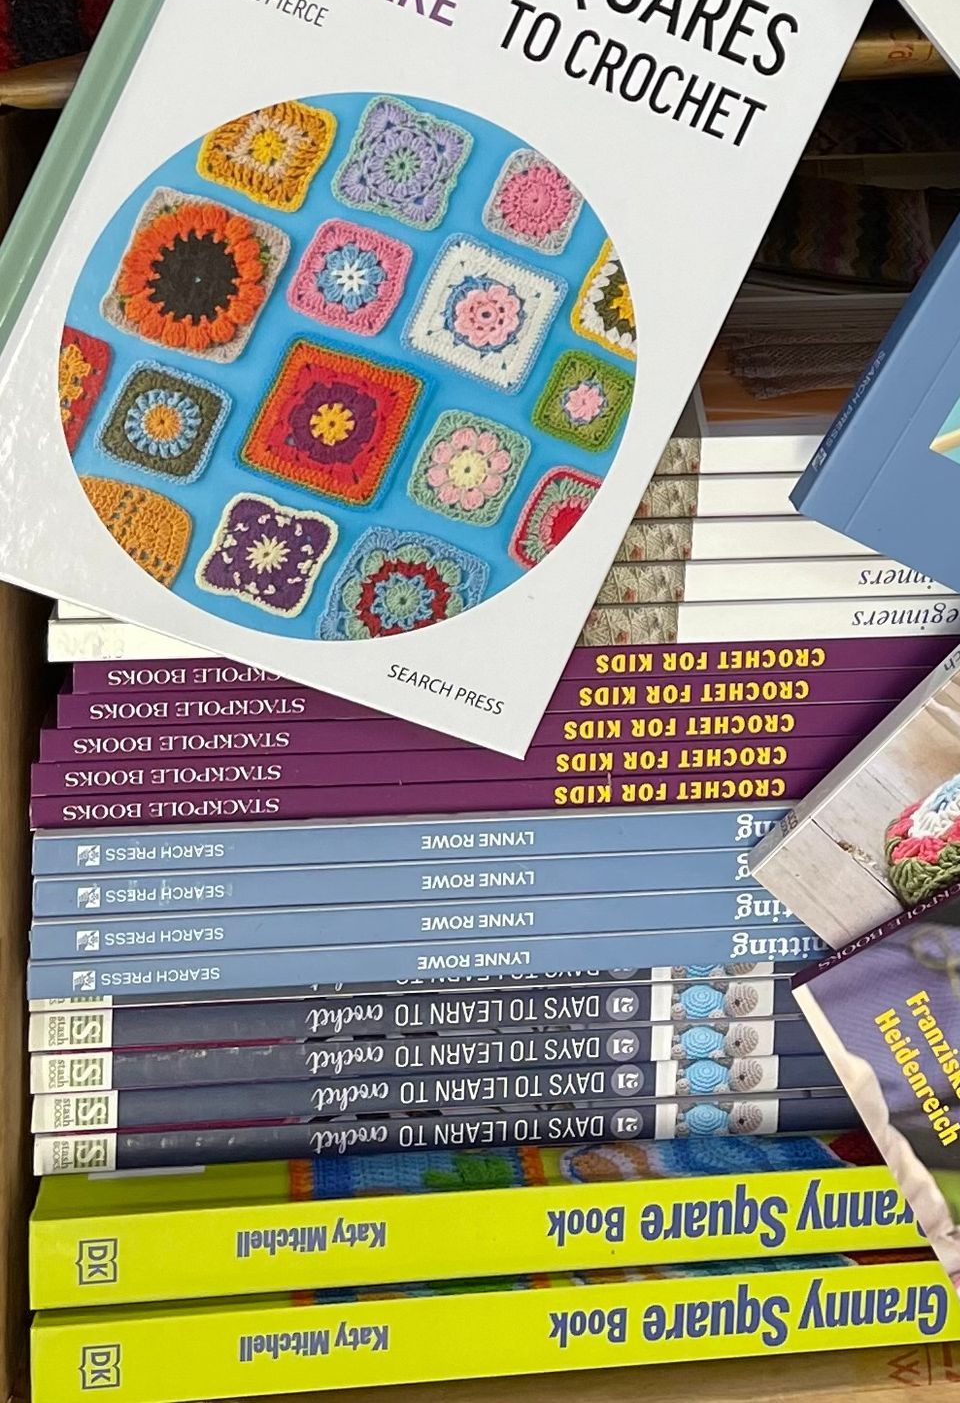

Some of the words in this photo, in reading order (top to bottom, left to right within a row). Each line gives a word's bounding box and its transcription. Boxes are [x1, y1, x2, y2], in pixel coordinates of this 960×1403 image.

[564, 28, 768, 147] CROCHET
[596, 653, 653, 674] KIDS
[662, 651, 708, 671] FOR
[717, 648, 826, 670] CROCHET
[387, 663, 454, 698] SEARCH
[453, 687, 505, 716] PRESS
[89, 702, 168, 720] BOOKS
[175, 697, 306, 717] STACKPOLE
[421, 834, 475, 850] ROWE
[479, 829, 535, 847] LYNNE
[105, 847, 157, 861] PRESS
[160, 844, 225, 860] SEARCH
[395, 1003, 424, 1027] TO
[430, 1000, 504, 1024] LEARN
[509, 999, 540, 1021] TO
[544, 994, 600, 1018] DAYS
[612, 996, 634, 1014] 21
[304, 1003, 383, 1033] crochet
[236, 1224, 328, 1258] Mitchell
[332, 1217, 387, 1250] Katy
[86, 1244, 109, 1279] DK
[642, 1284, 790, 1347] Square
[797, 1277, 949, 1335] Granny
[548, 1307, 628, 1349] Book
